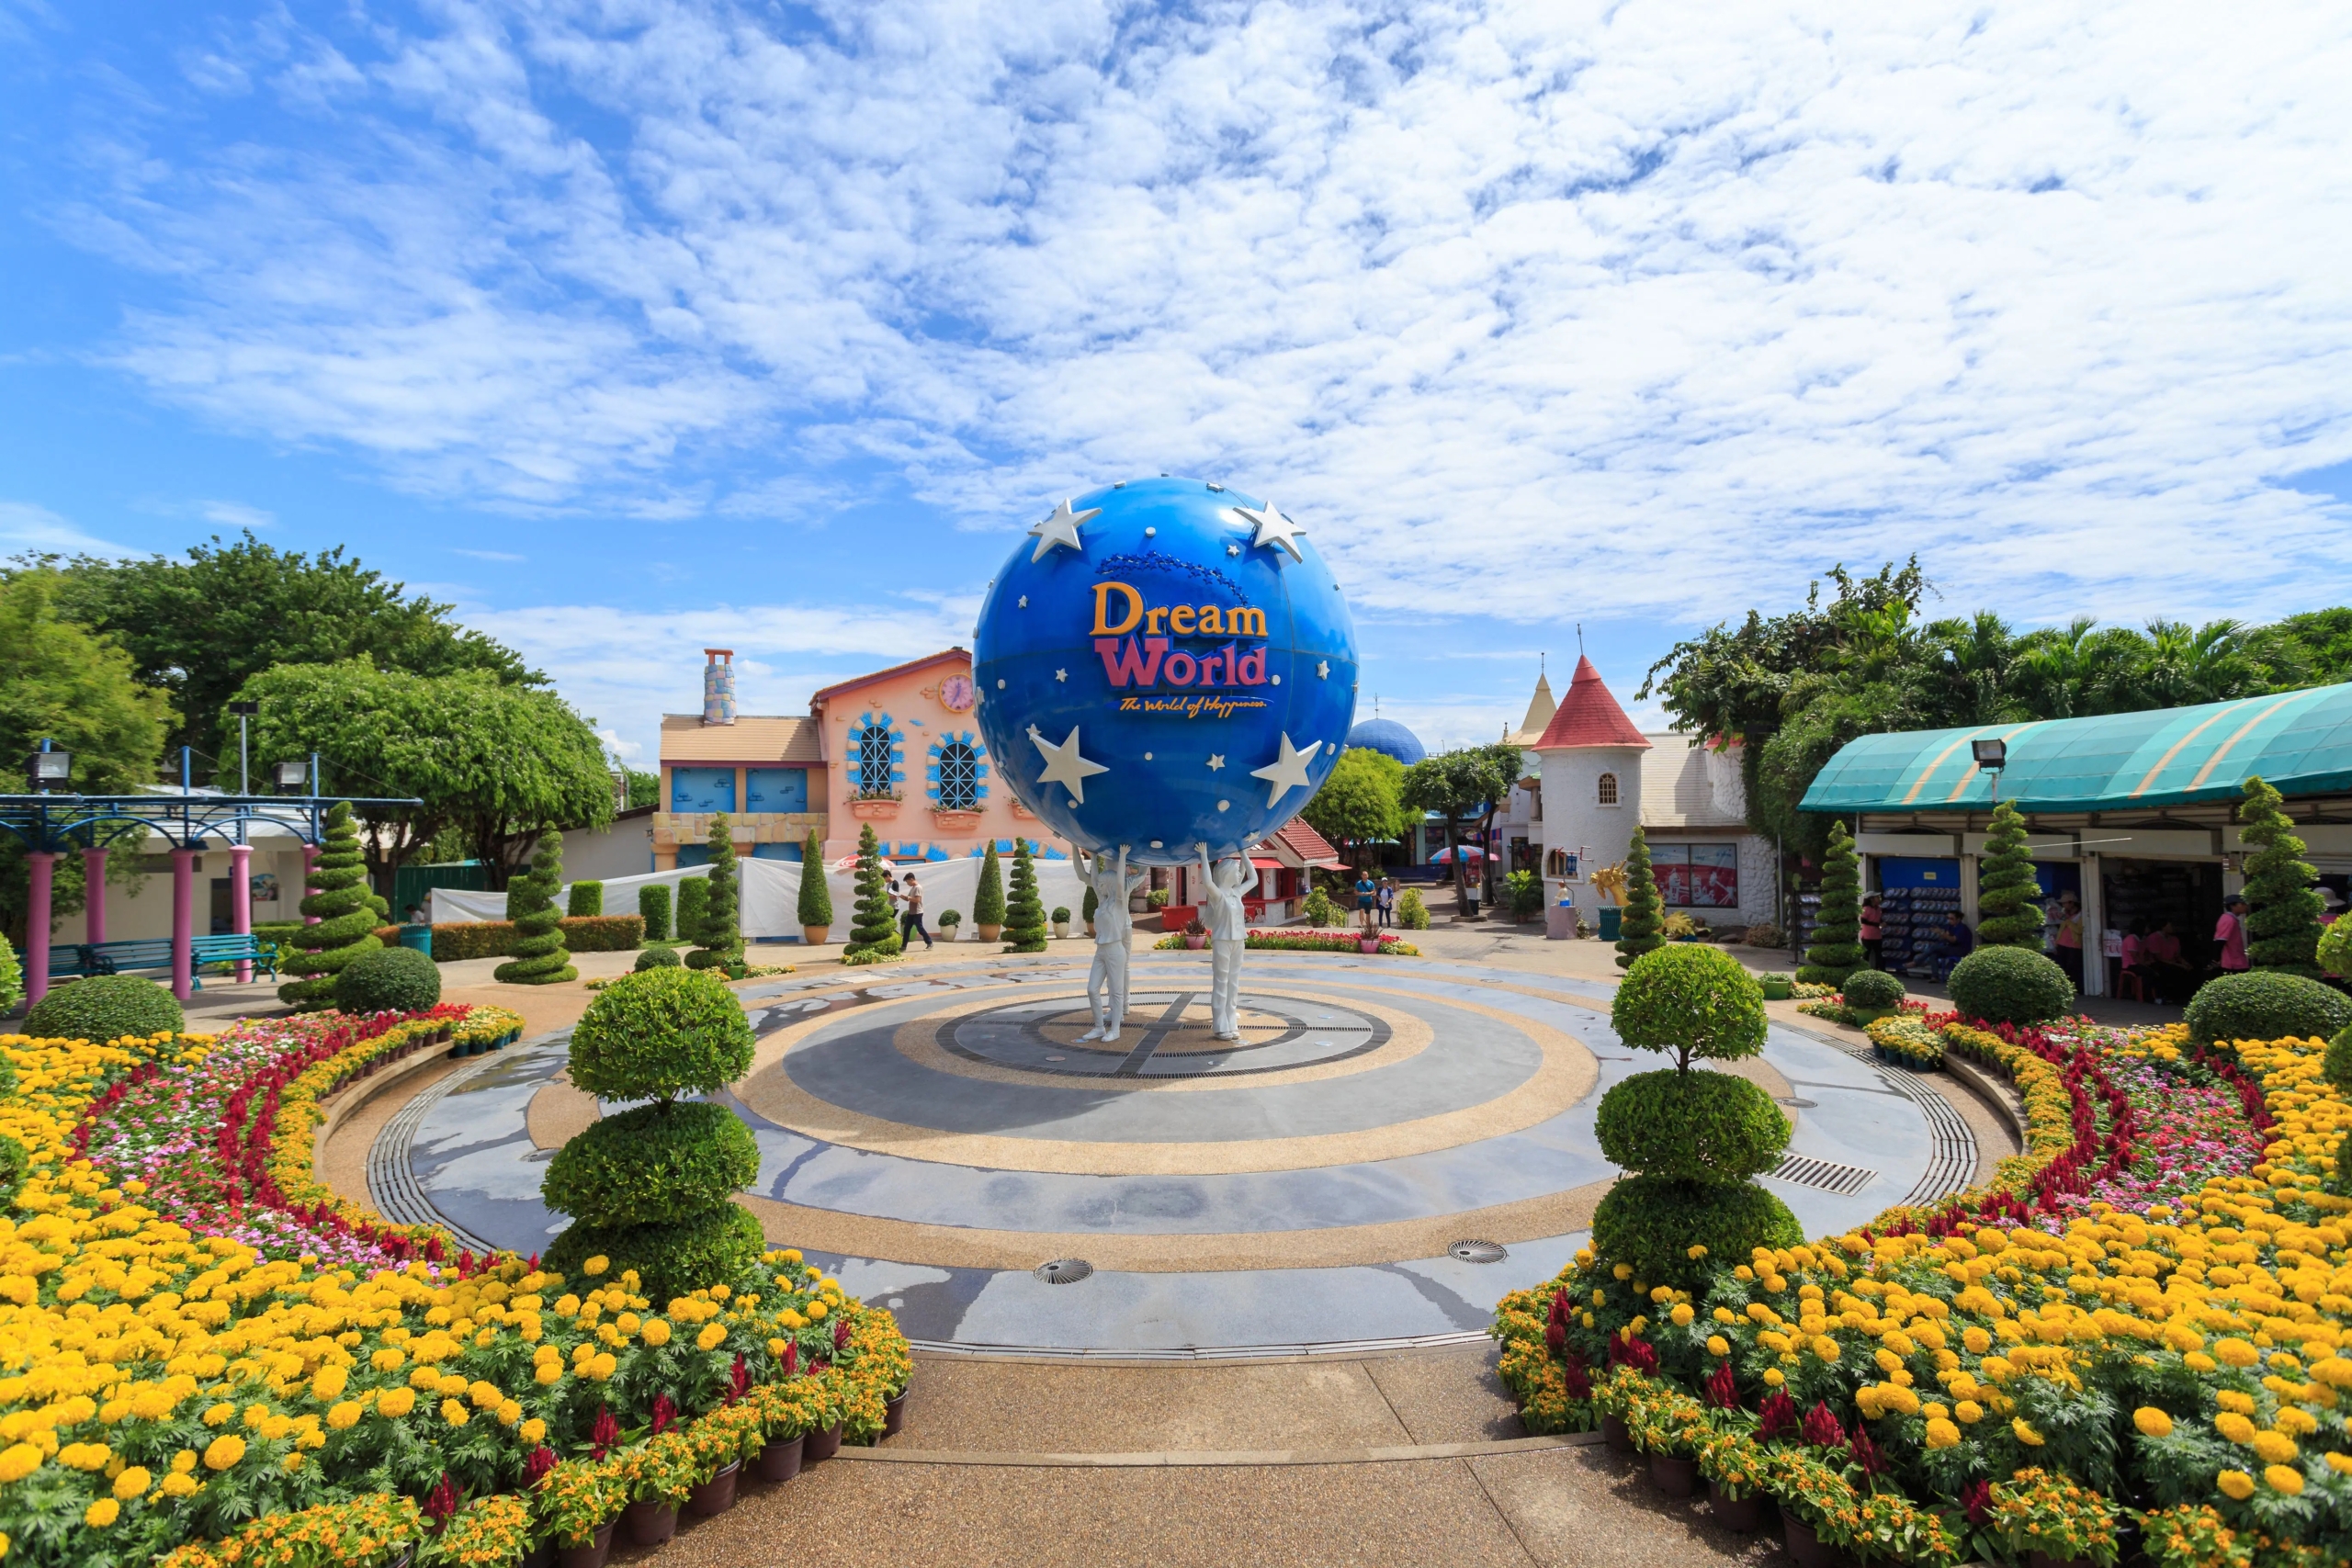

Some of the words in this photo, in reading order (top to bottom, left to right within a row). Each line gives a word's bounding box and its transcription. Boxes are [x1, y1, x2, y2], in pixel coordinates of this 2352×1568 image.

[1089, 581, 1269, 637] Dream
[1094, 635, 1269, 687] World
[1119, 696, 1141, 711] The
[1144, 696, 1188, 711] World
[1186, 695, 1205, 719] of
